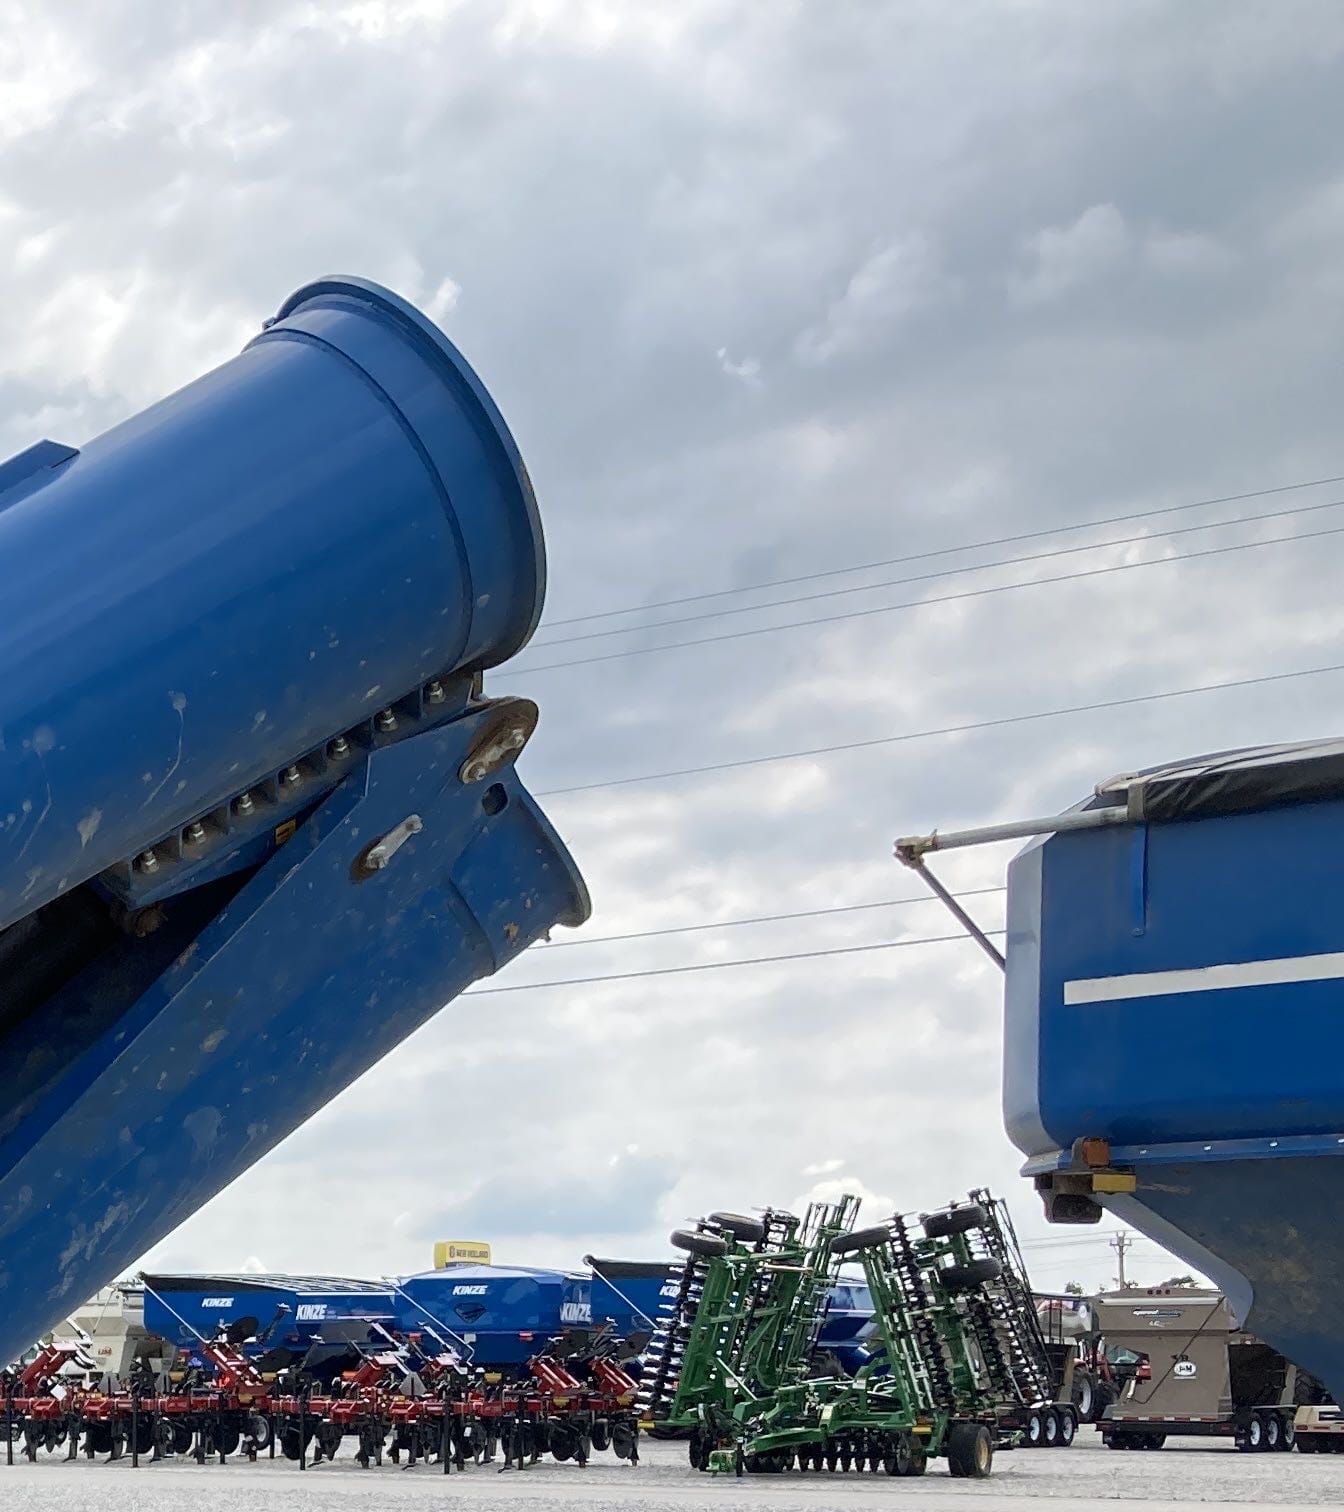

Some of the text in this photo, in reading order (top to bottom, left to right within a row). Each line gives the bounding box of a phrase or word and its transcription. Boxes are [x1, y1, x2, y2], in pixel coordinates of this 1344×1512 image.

[452, 1285, 488, 1296] KINZE
[201, 1297, 235, 1308] KINZE
[295, 1304, 328, 1321] KINZE
[560, 1302, 592, 1322] KINZE
